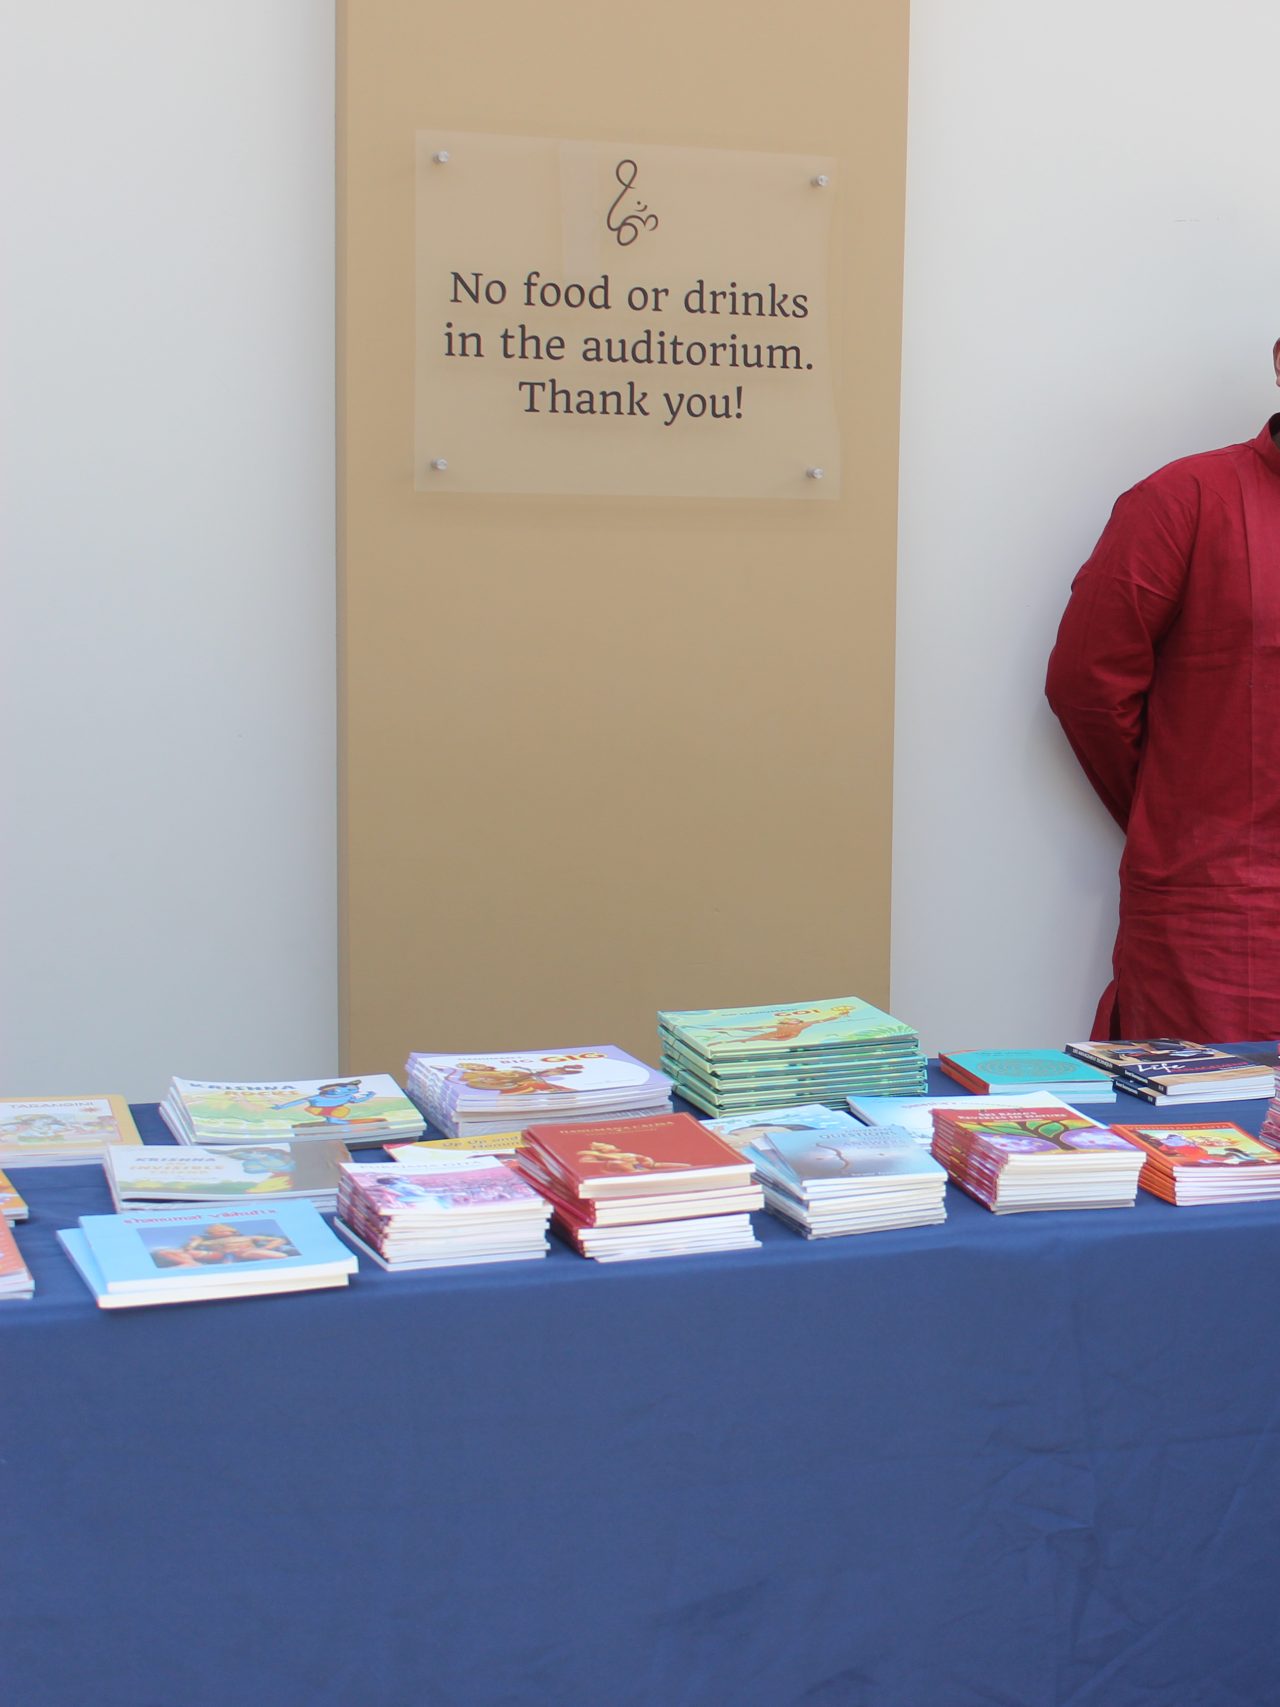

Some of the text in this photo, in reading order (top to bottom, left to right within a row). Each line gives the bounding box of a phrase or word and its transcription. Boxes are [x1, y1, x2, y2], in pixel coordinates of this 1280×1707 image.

[449, 271, 809, 319] No food or drinks
[443, 321, 814, 370] in the auditorium.
[518, 378, 744, 427] Thank you!
[540, 1052, 608, 1063] GIG
[1137, 1062, 1186, 1074] Life
